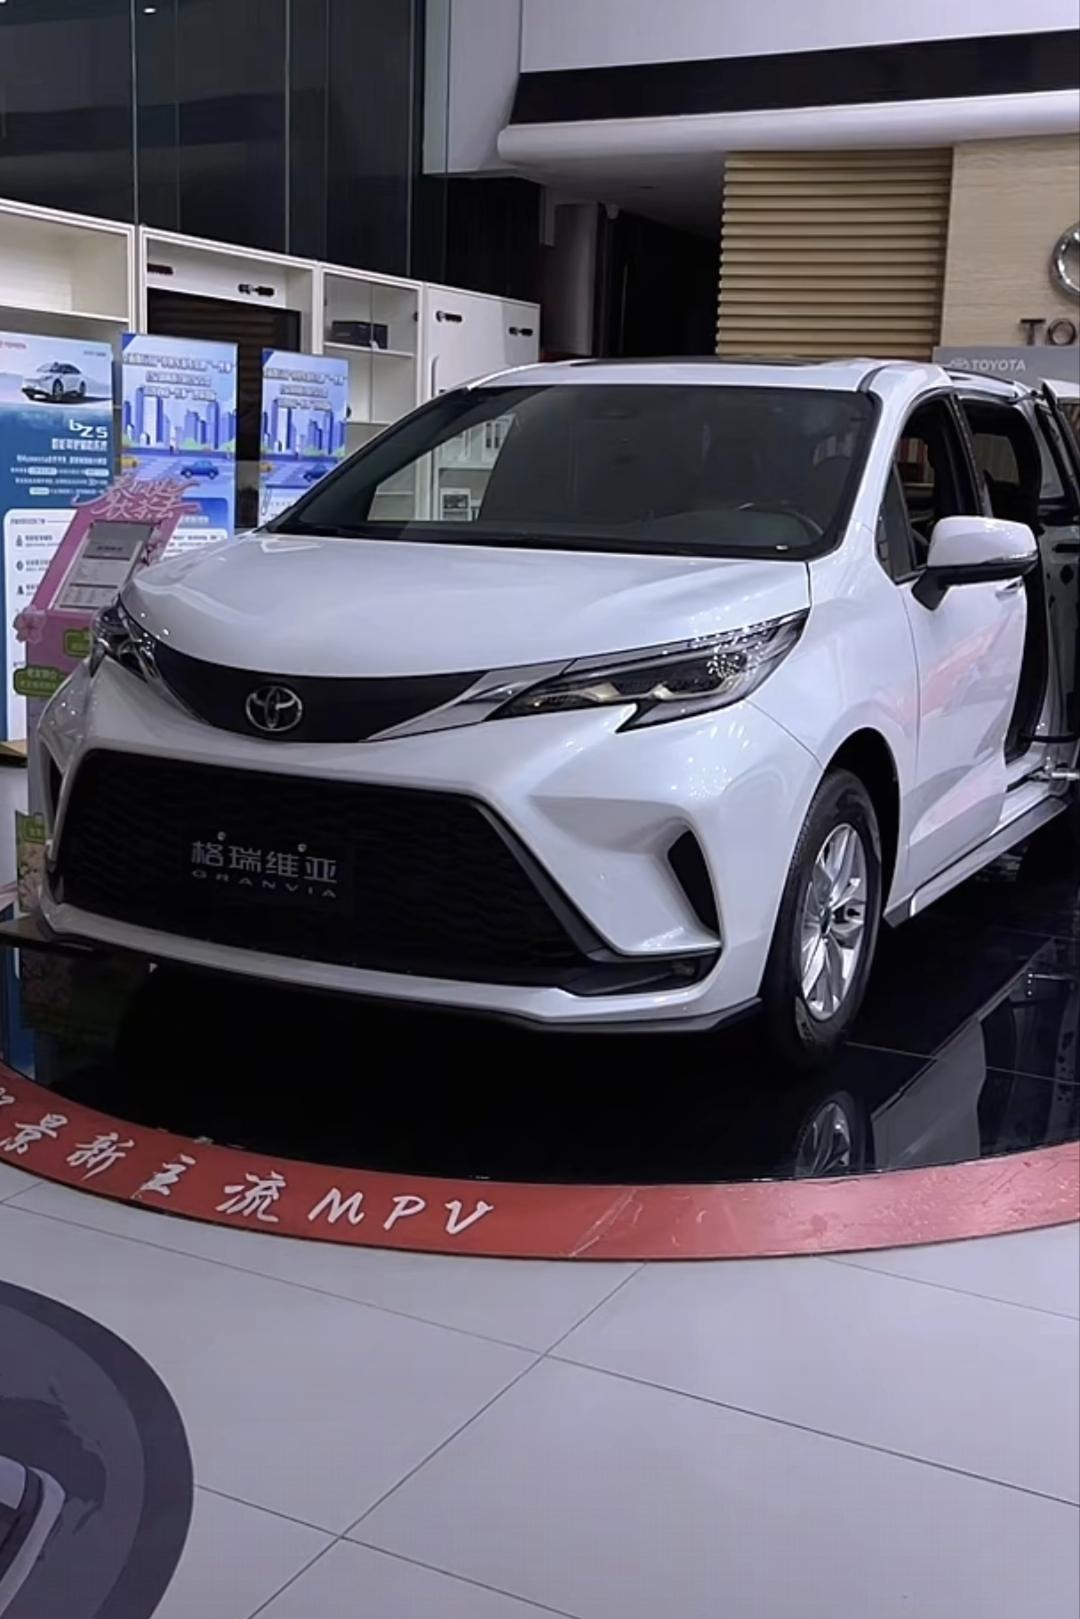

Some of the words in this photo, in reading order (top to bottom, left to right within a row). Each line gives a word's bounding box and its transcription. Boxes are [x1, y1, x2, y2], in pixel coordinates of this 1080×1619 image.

[1020, 318, 1078, 347] TO
[971, 359, 1027, 372] TOYOTA
[191, 840, 338, 884] 格瑞维亚
[191, 868, 337, 898] GRANVIA
